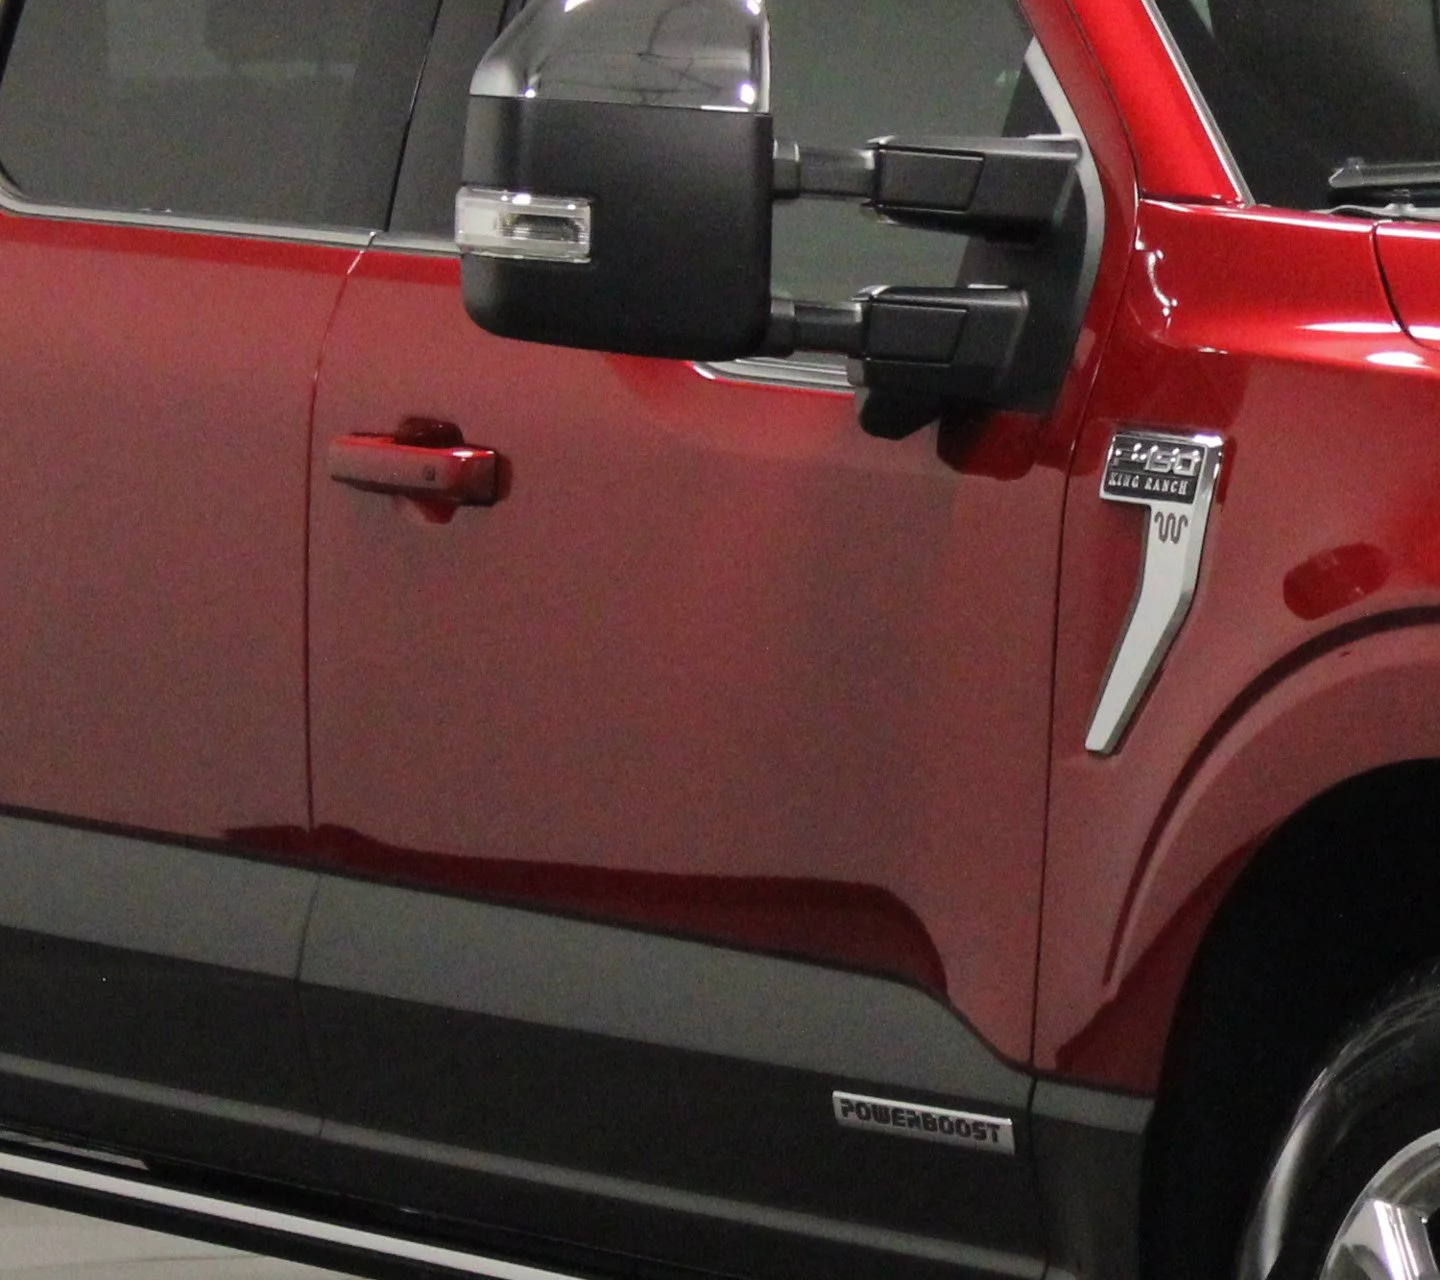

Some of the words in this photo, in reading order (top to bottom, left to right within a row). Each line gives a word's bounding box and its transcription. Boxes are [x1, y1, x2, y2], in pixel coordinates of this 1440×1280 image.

[1108, 472, 1141, 489] KING
[1144, 477, 1189, 496] RANCH
[840, 1098, 1000, 1144] POWERBOOST
